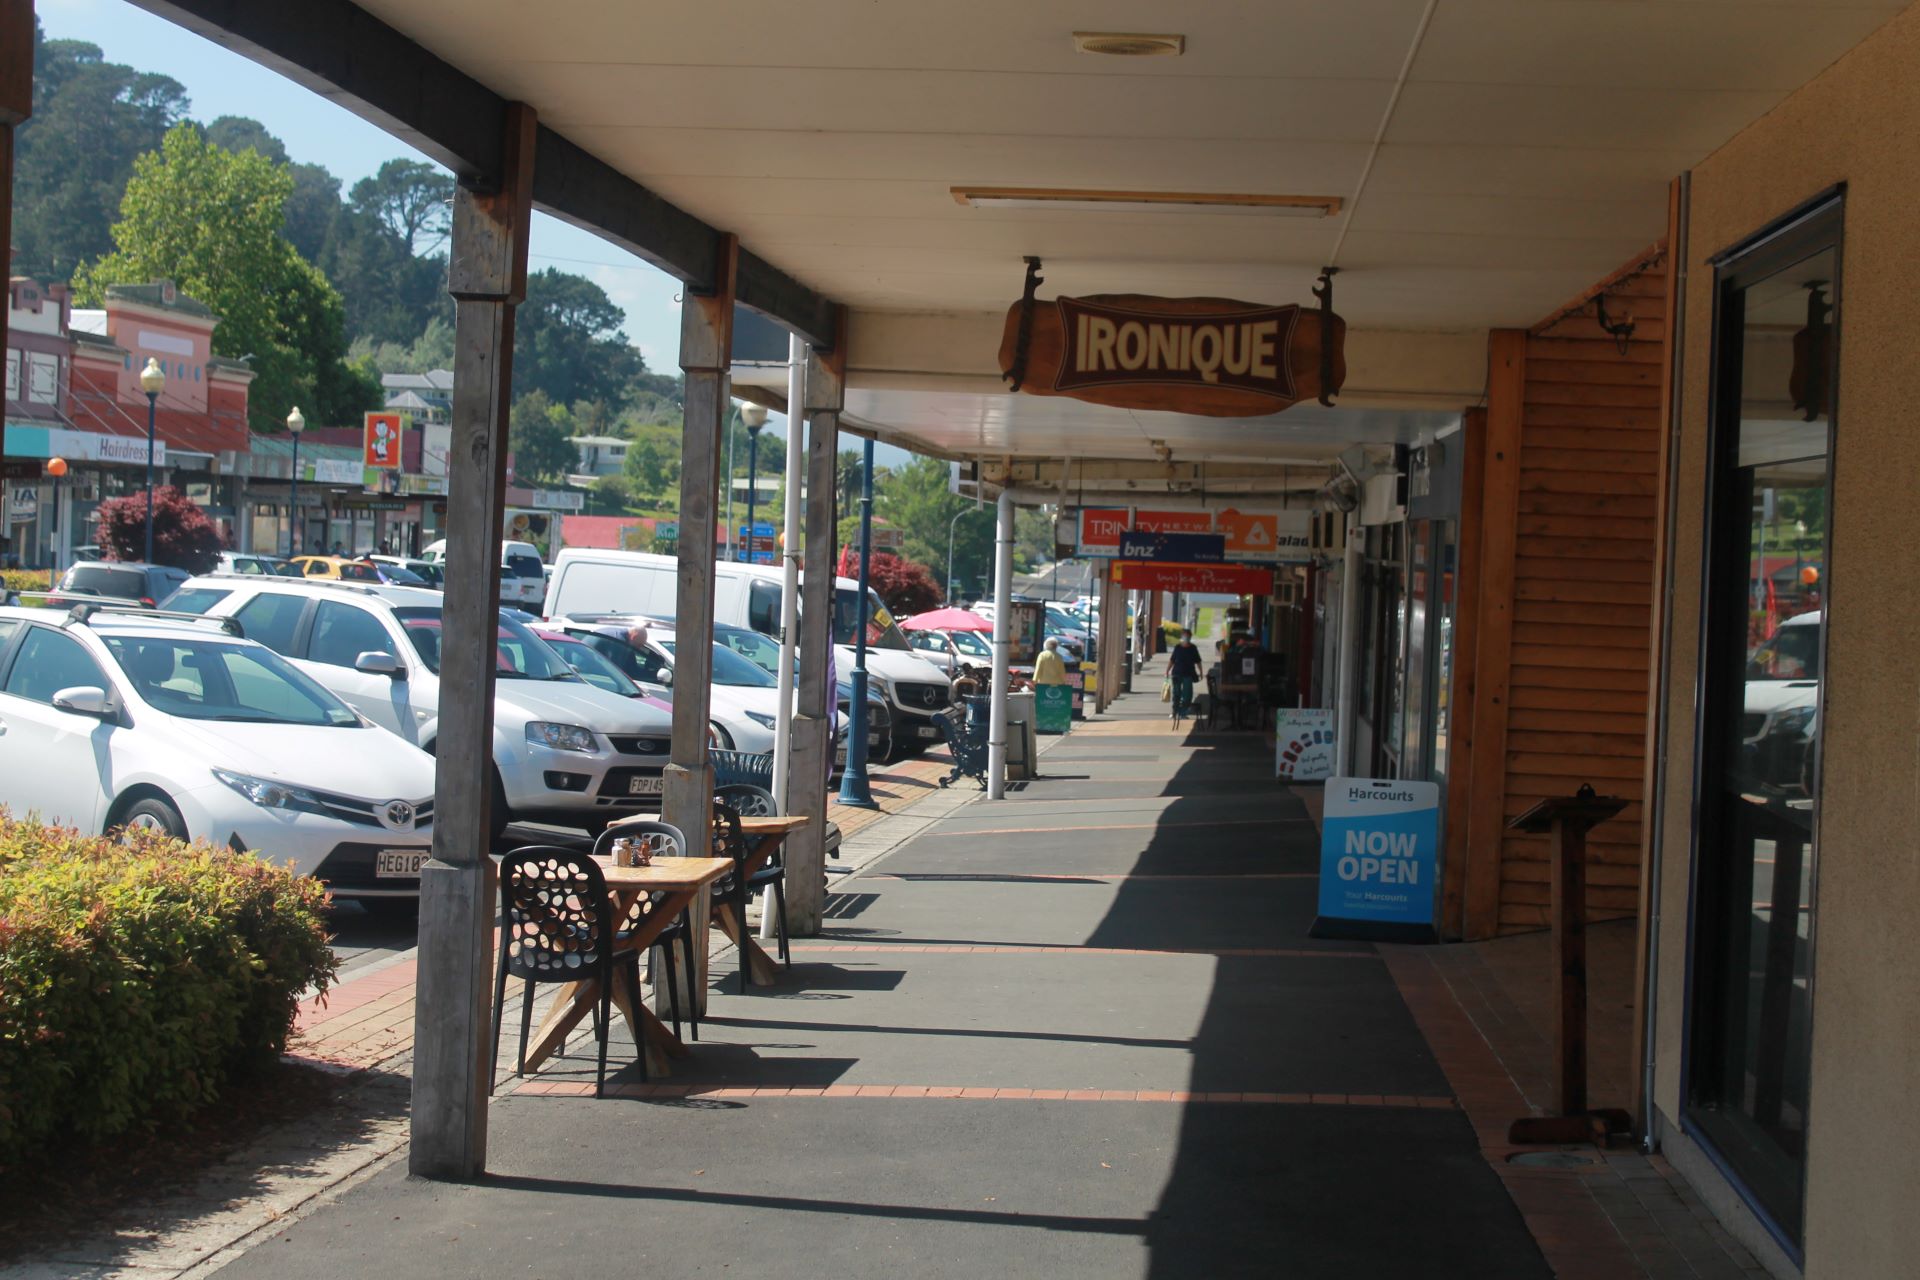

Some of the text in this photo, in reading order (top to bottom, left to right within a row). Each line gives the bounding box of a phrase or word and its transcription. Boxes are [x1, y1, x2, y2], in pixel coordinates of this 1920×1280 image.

[1076, 313, 1279, 384] IRONIQUE
[100, 437, 164, 464] Hairdressrs
[1090, 519, 1159, 535] TRINTY
[1124, 541, 1154, 557] bnz
[1349, 787, 1414, 802] Harcourts
[1345, 830, 1417, 857] NOW
[1337, 856, 1418, 885] OPEN
